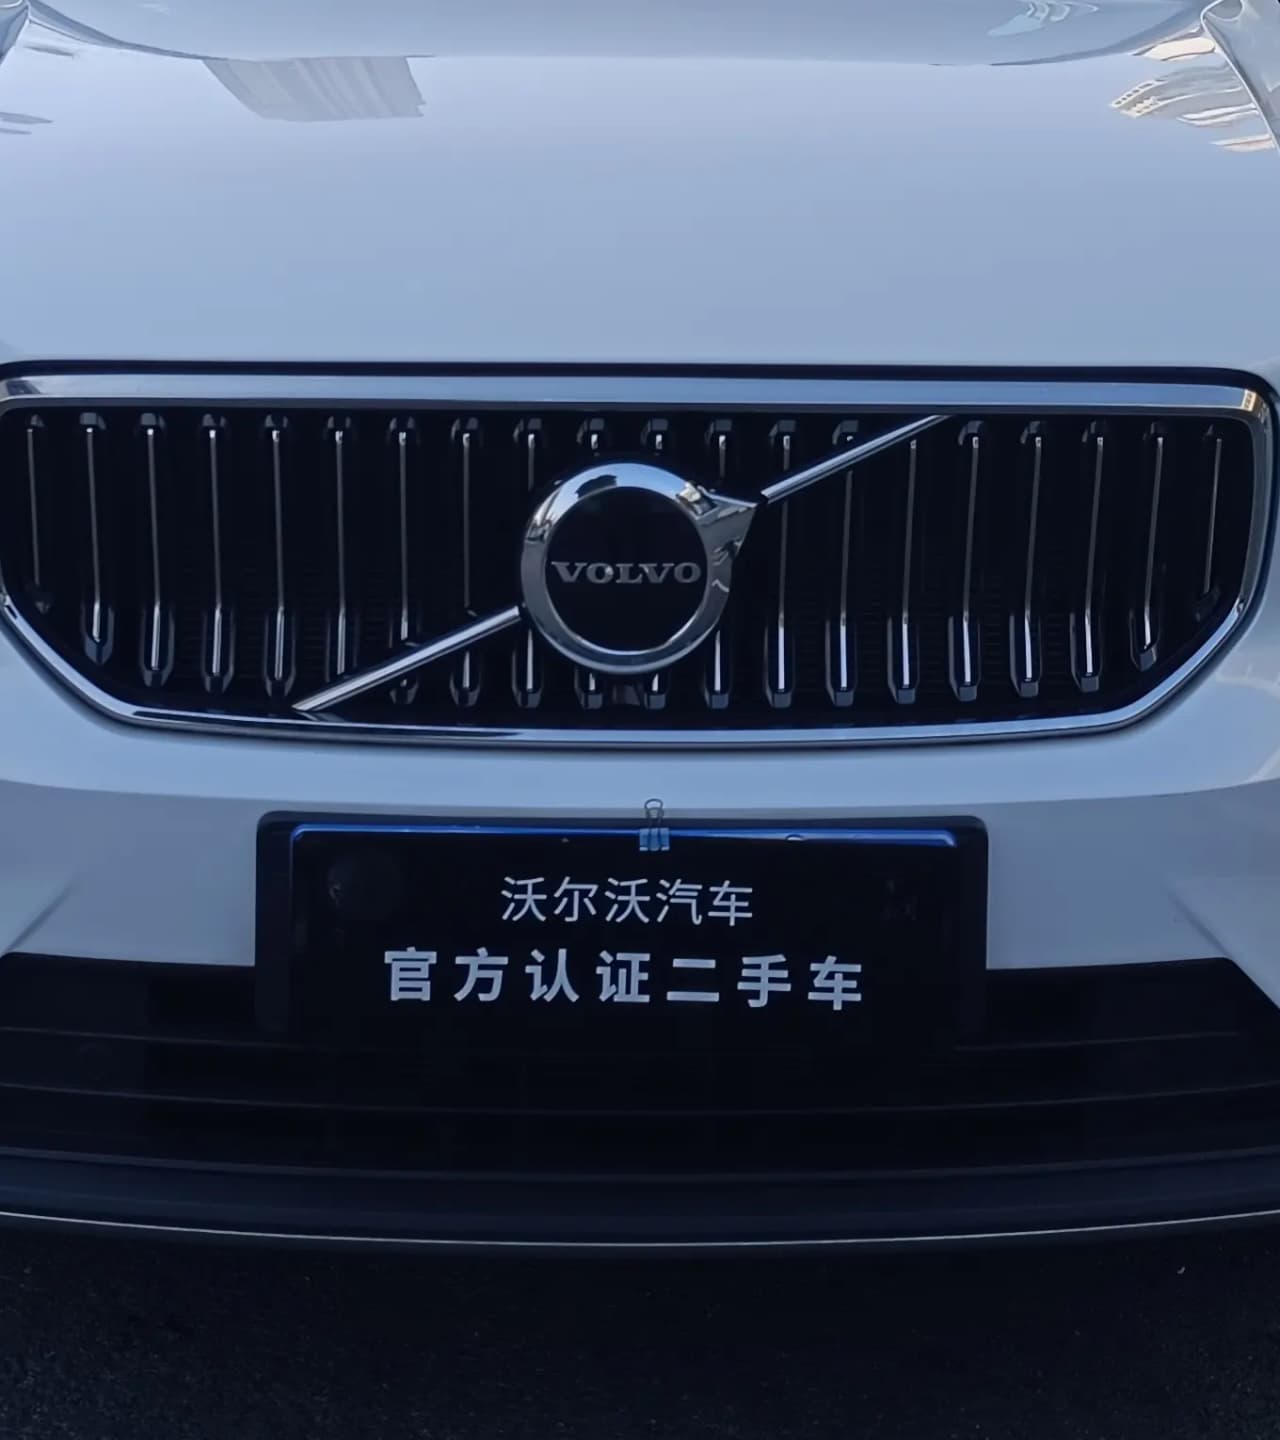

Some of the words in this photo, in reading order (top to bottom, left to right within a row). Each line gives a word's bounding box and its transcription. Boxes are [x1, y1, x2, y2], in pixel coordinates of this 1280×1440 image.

[550, 560, 703, 584] VOLVO
[500, 876, 754, 927] 沃尔沃汽车
[384, 946, 863, 1011] 官方认证二手车
